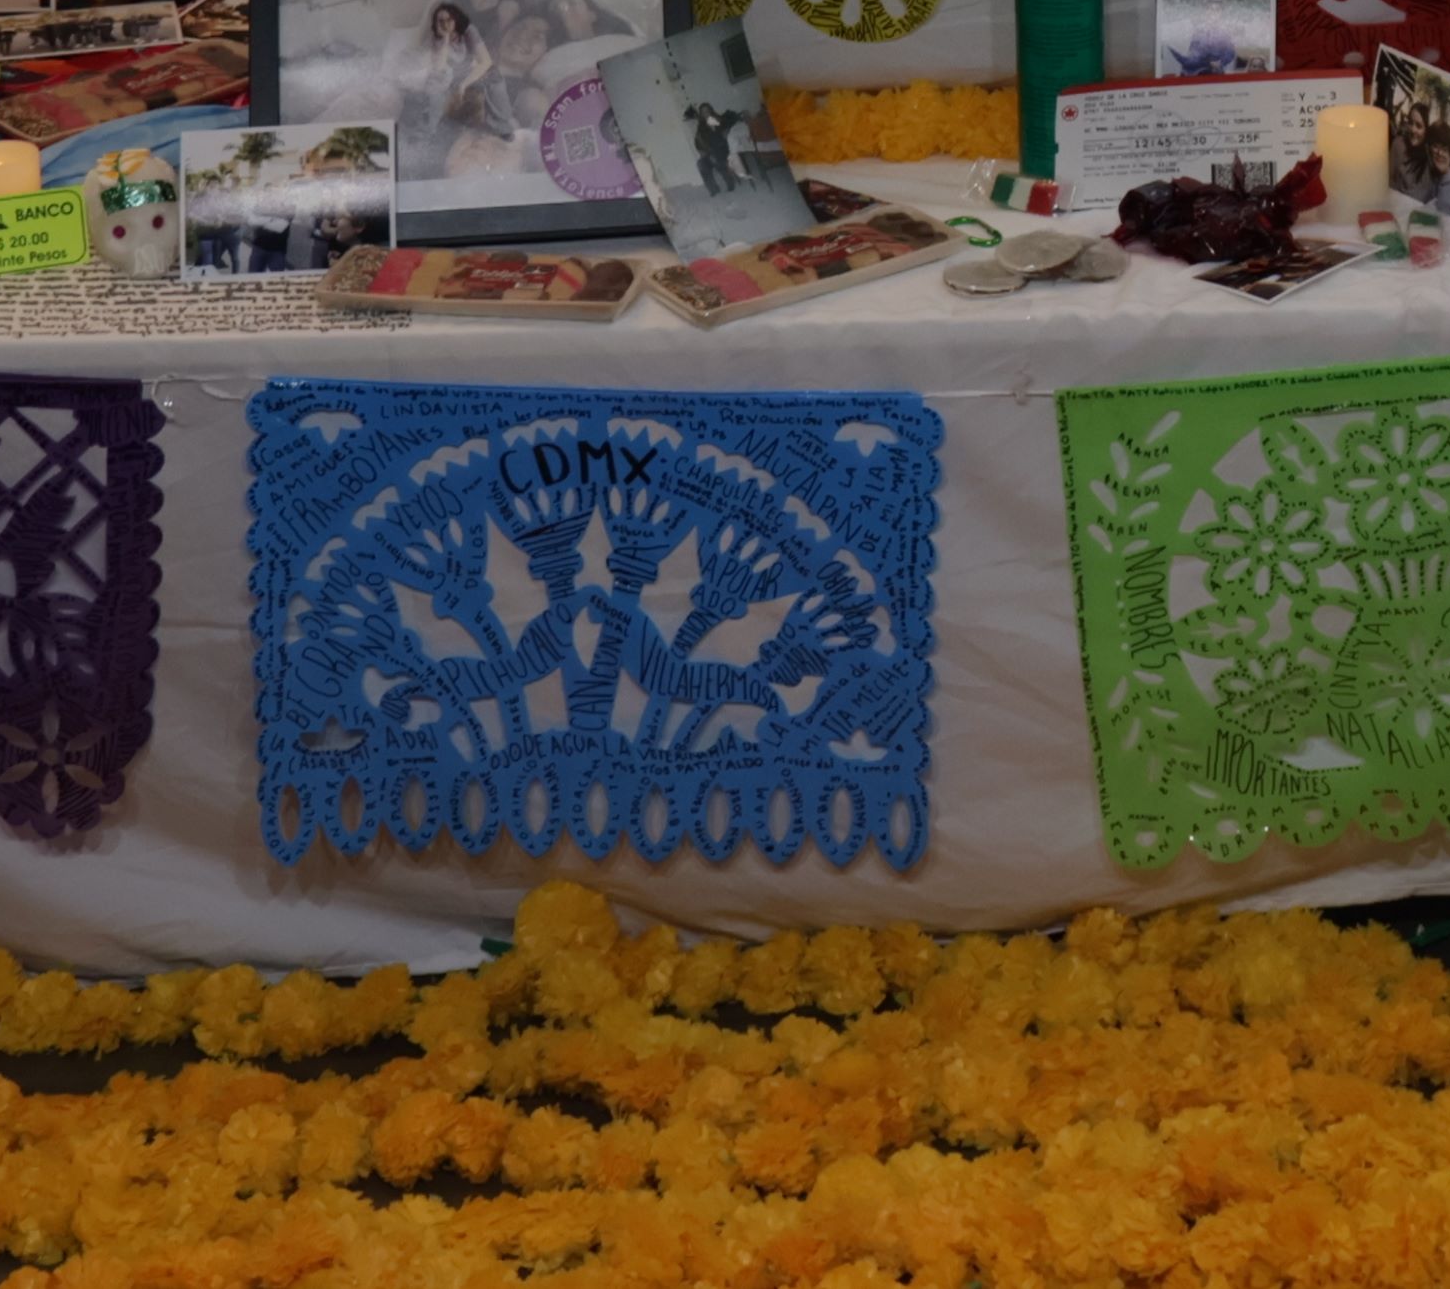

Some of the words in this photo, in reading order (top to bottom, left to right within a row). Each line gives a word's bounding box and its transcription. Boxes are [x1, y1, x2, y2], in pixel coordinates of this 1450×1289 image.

[1133, 138, 1173, 150] 12:45
[14, 200, 75, 223] BANCO
[8, 231, 50, 249] 20.00
[29, 247, 68, 266] Pesos
[499, 439, 660, 496] CDMX
[1122, 544, 1182, 673] NOMBRES
[1205, 728, 1333, 799] IMPORTANTES
